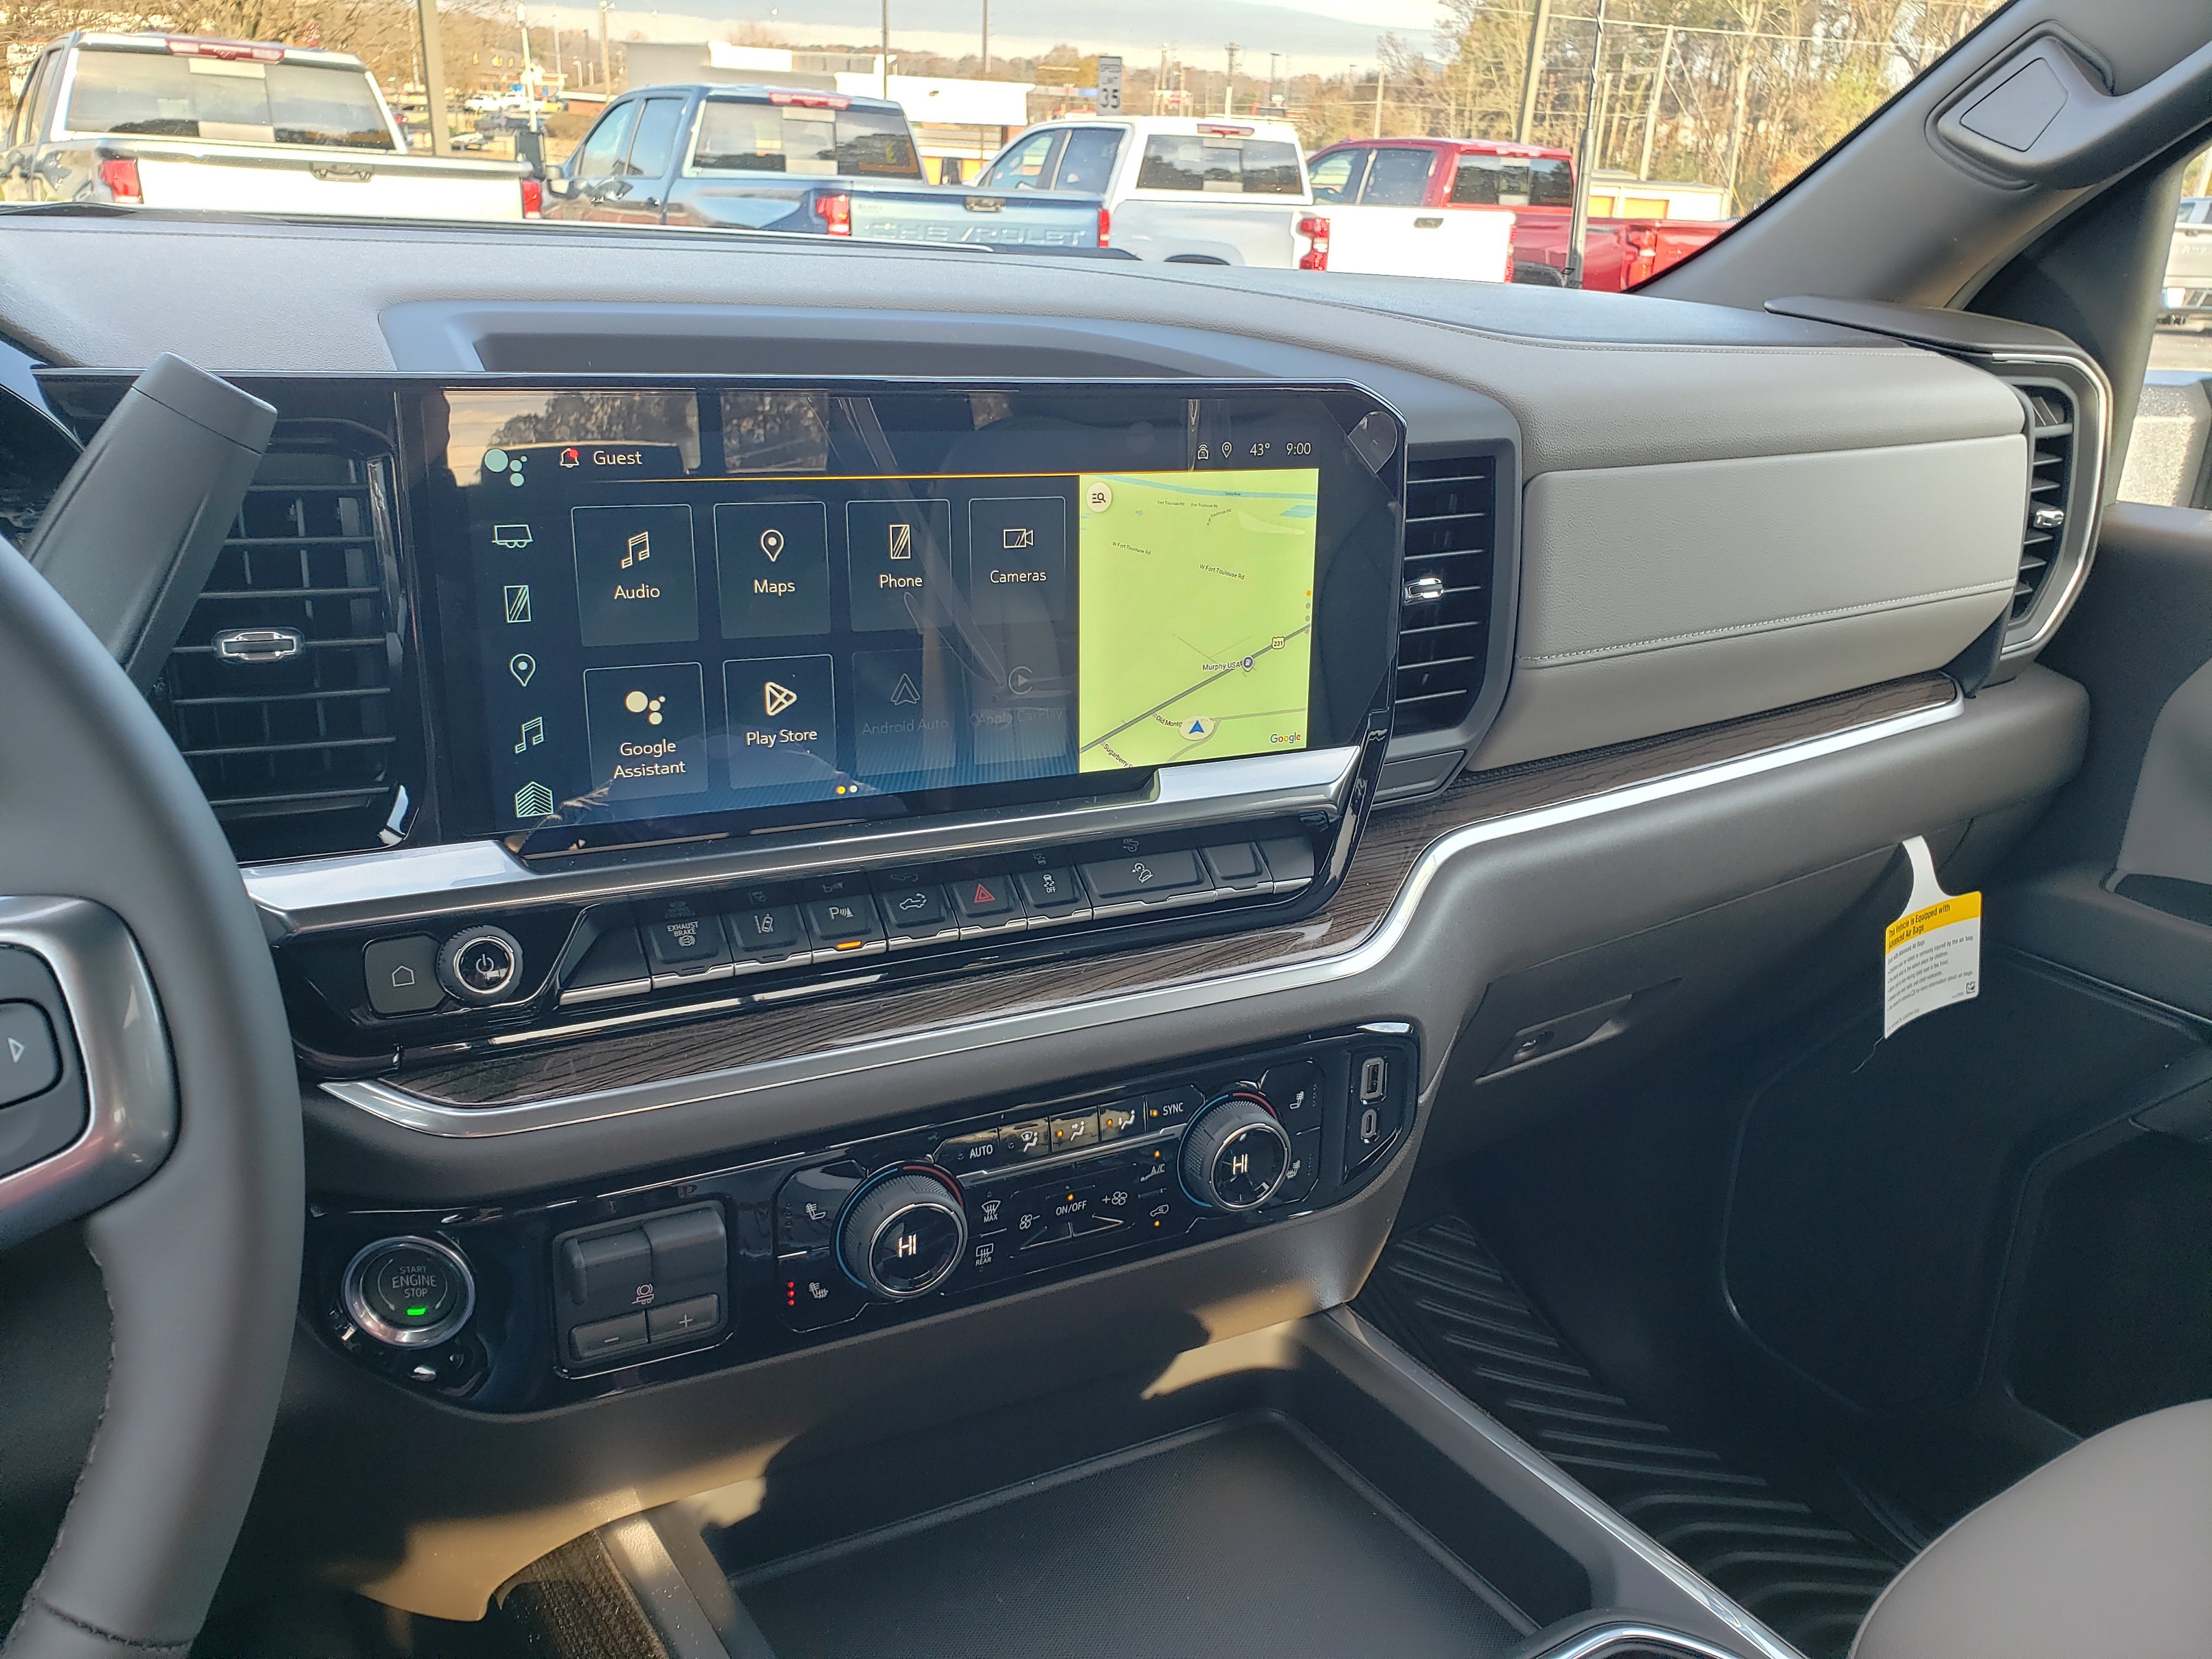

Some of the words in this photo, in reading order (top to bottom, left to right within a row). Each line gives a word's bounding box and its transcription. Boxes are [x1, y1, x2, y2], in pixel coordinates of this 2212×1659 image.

[1286, 442, 1312, 455] 9:00
[594, 450, 643, 465] Guest
[990, 569, 1047, 584] Cameras
[1216, 568, 1237, 578] Toulouse
[753, 579, 795, 596] Maps
[879, 573, 923, 589] Phone
[614, 583, 660, 600] Audio
[1202, 663, 1226, 671] Murphy
[978, 712, 1013, 726] Apple
[1017, 708, 1064, 722] CarPlay
[1156, 715, 1166, 724] Old
[862, 720, 914, 735] Android
[917, 719, 949, 731] Auto
[746, 731, 776, 748] Play
[779, 730, 818, 743] Store
[1270, 732, 1301, 743] Google
[620, 738, 676, 757] Google
[1103, 743, 1128, 768] Sugarberry
[613, 760, 686, 779] Assistant
[829, 907, 838, 919] P
[1896, 919, 1909, 933] Vehicle
[1910, 917, 1914, 926] is
[1916, 907, 1937, 923] Equipped
[1939, 904, 1950, 914] with
[667, 921, 699, 932] EXHAUST
[674, 927, 697, 937] BRAKE
[1913, 924, 1923, 935] Bags
[1163, 1102, 1183, 1116] SYNC
[969, 1144, 993, 1159] AUTO
[1152, 1164, 1165, 1174] A/C
[1233, 1153, 1248, 1175] HI
[1056, 1200, 1087, 1216] ON/OFF
[984, 1213, 998, 1223] MAX
[899, 1234, 917, 1258] HI
[975, 1256, 992, 1266] REAR
[399, 1266, 427, 1274] START
[392, 1274, 437, 1289] ENGINE
[404, 1288, 427, 1298] STOP
